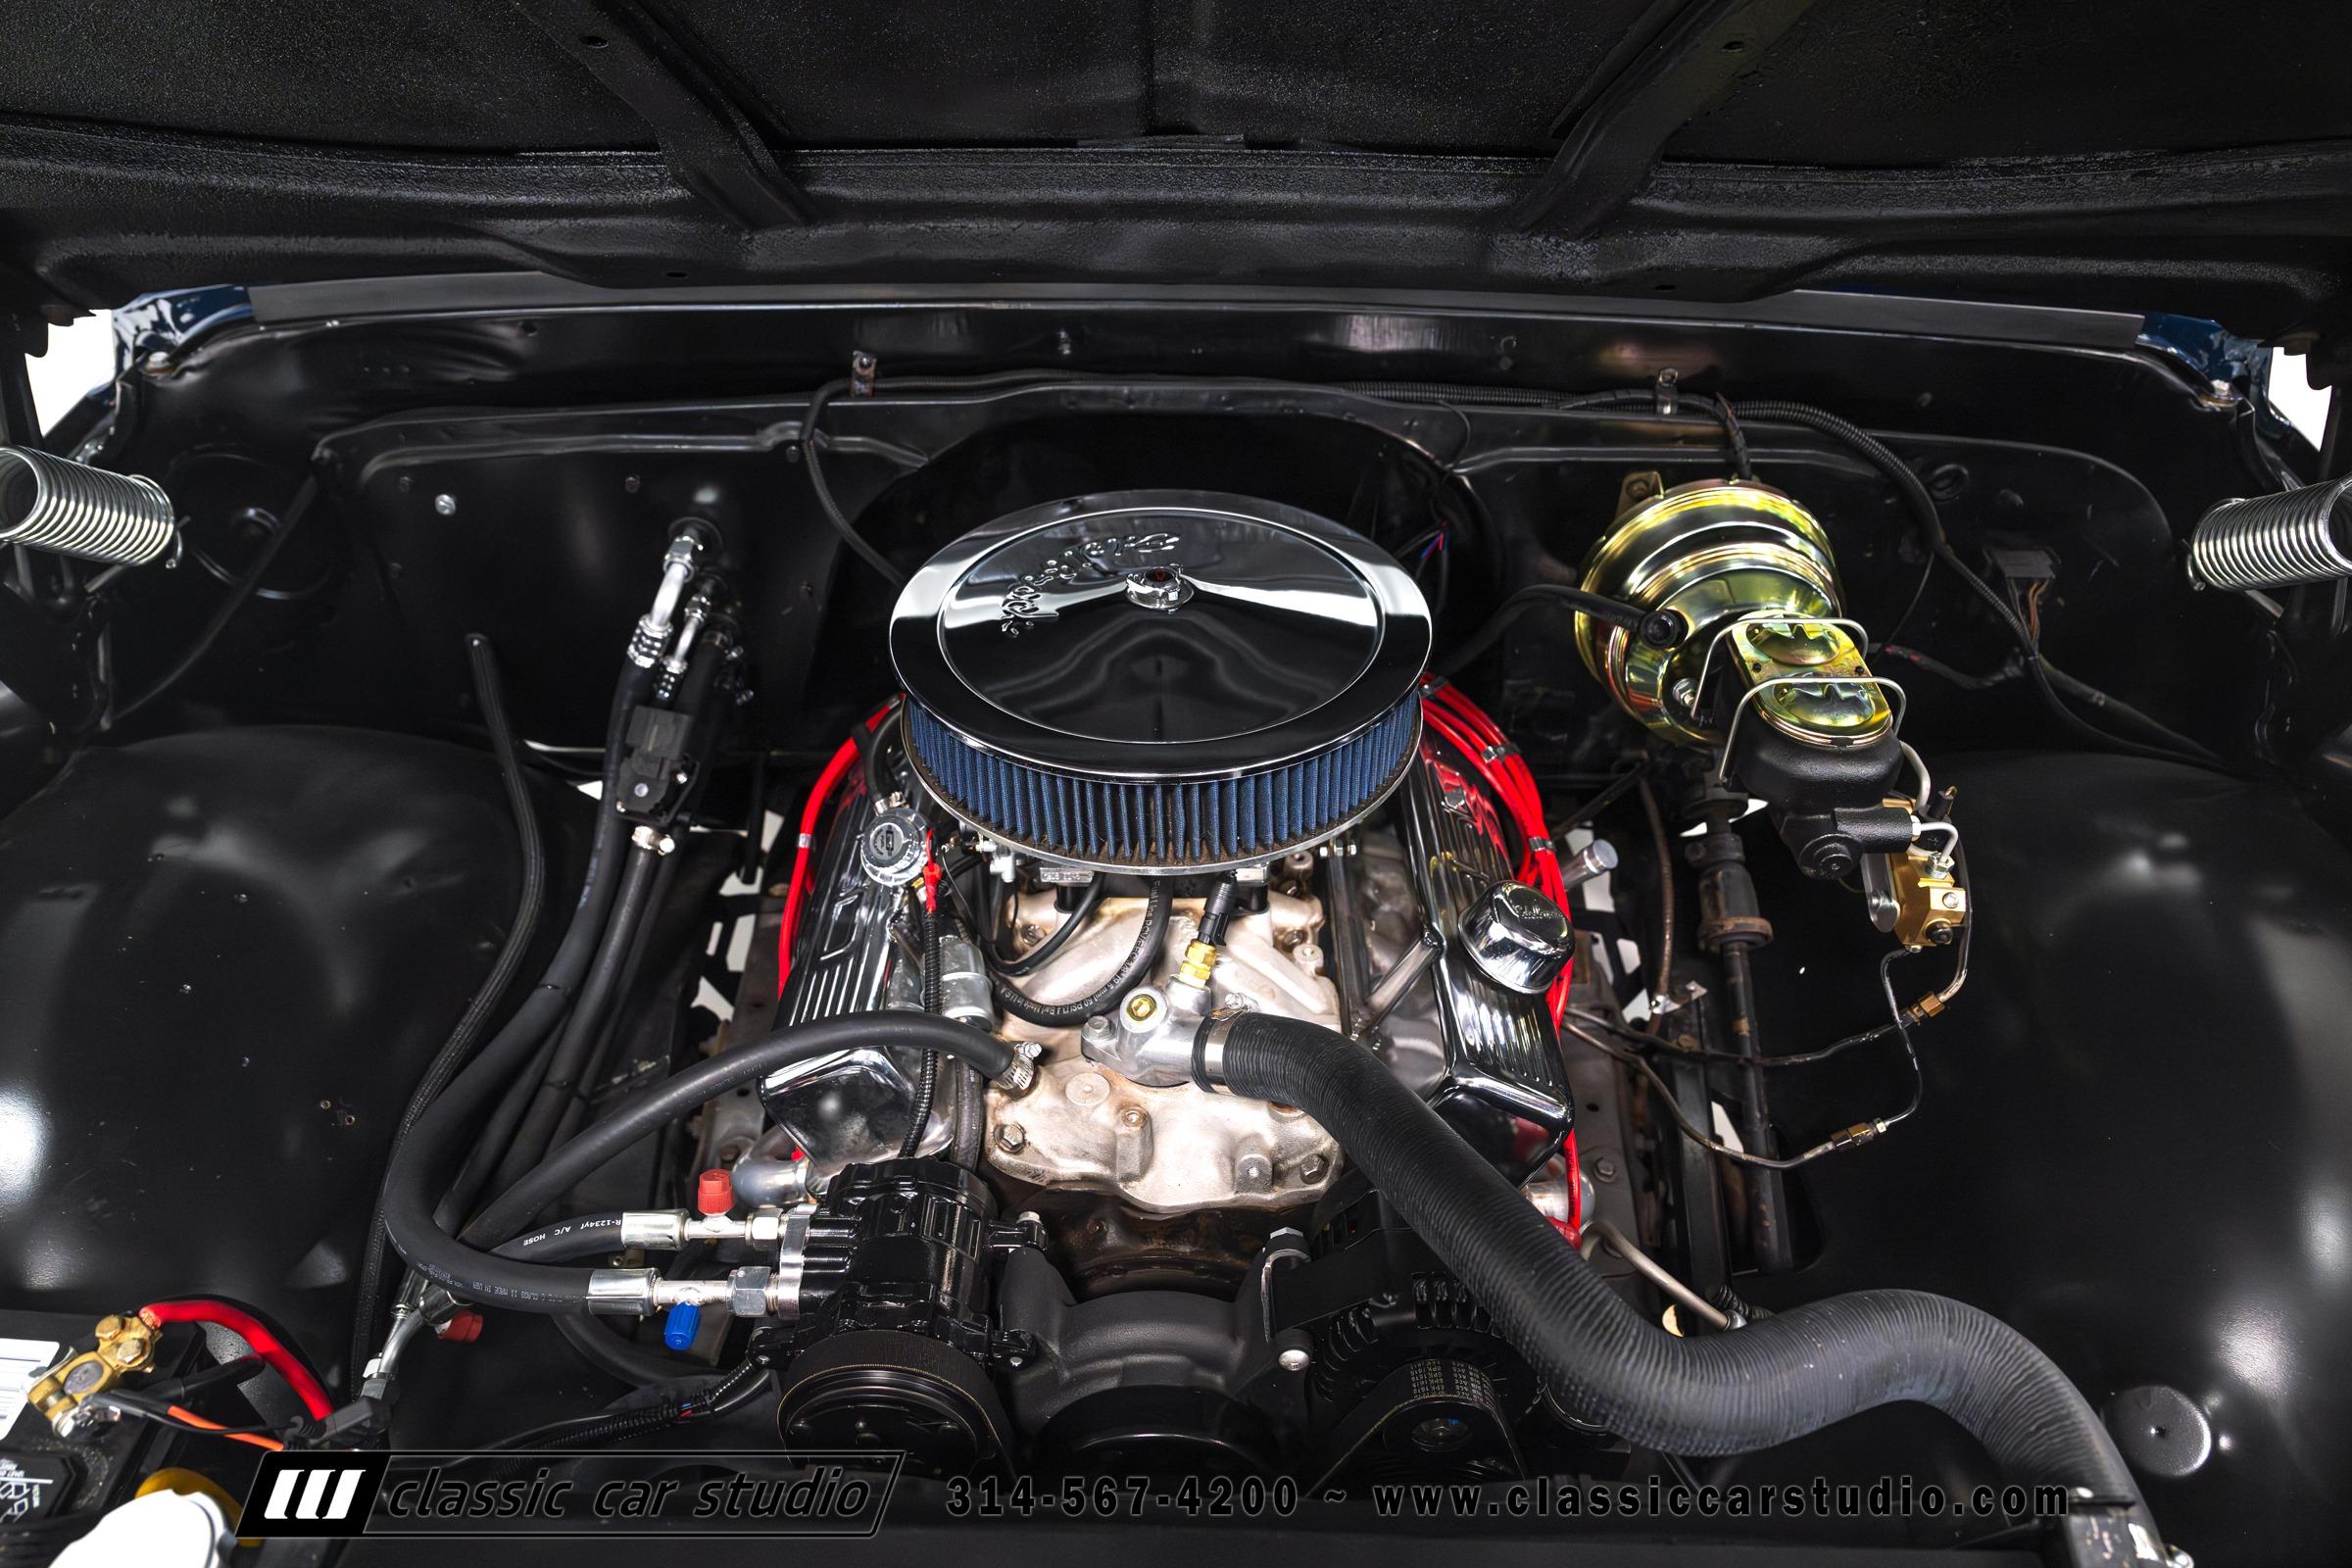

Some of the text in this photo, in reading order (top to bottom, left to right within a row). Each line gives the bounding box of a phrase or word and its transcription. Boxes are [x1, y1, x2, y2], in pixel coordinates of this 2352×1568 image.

[523, 1219, 621, 1247] R-1234yf A/C HOSE
